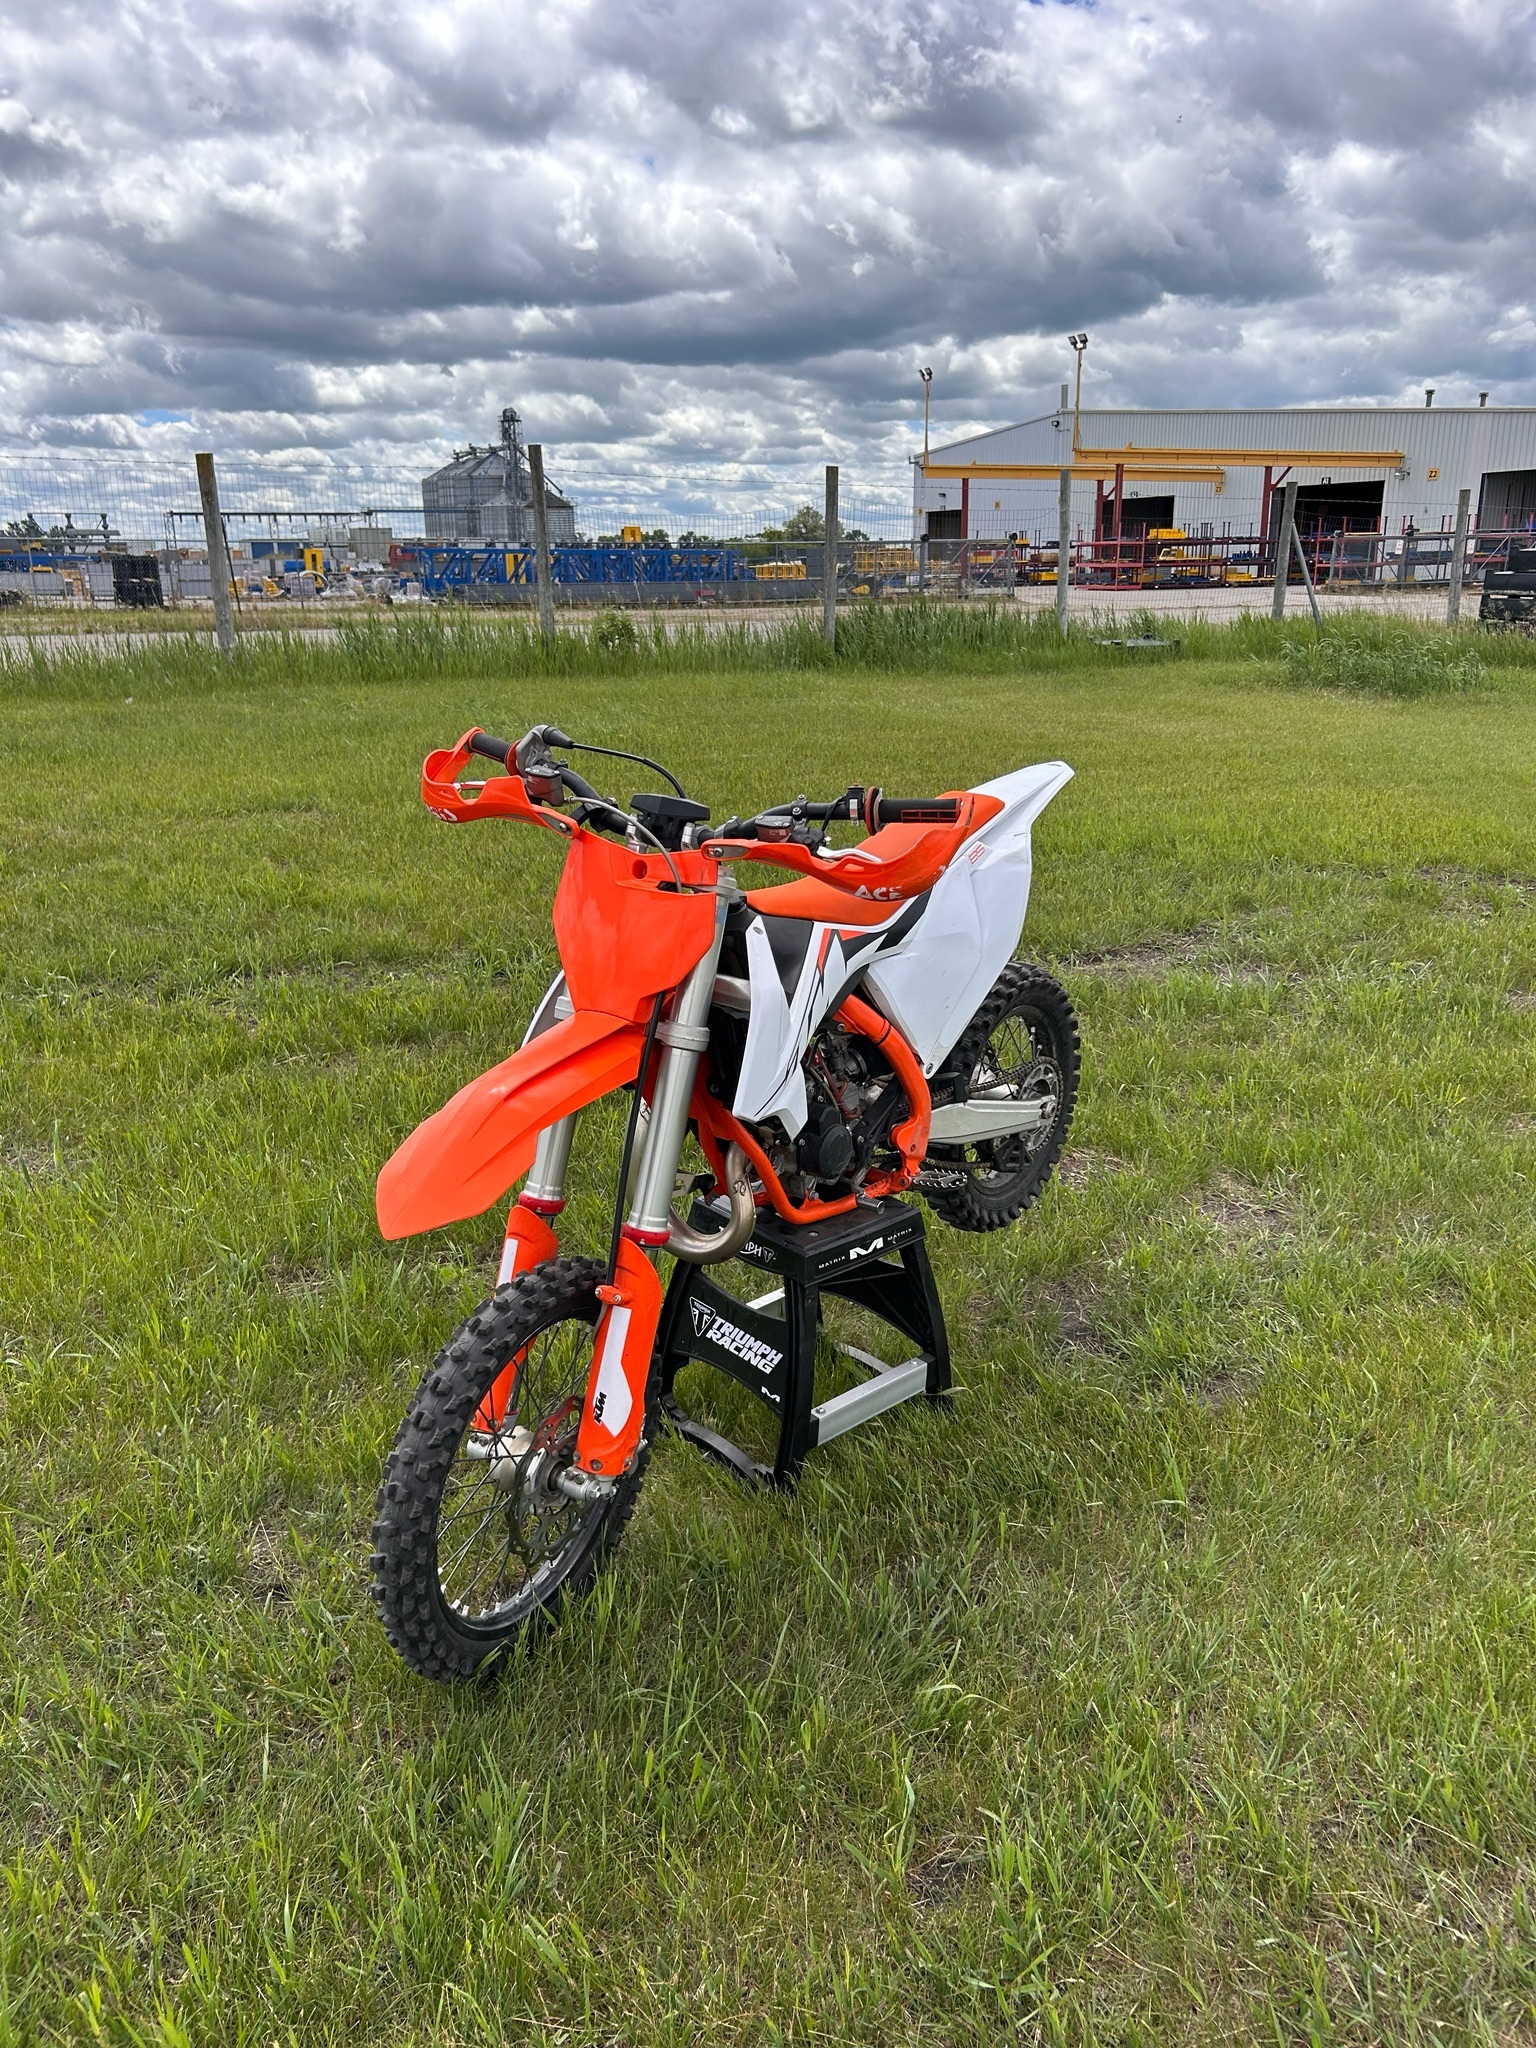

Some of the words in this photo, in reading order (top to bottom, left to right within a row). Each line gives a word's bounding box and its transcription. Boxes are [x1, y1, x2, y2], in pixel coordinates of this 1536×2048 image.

[818, 1255, 846, 1269] MATRIX
[887, 1228, 913, 1241] MATRIX
[705, 1328, 776, 1375] RACING
[712, 1315, 784, 1365] TRIUMPH
[593, 1391, 607, 1424] KTM
